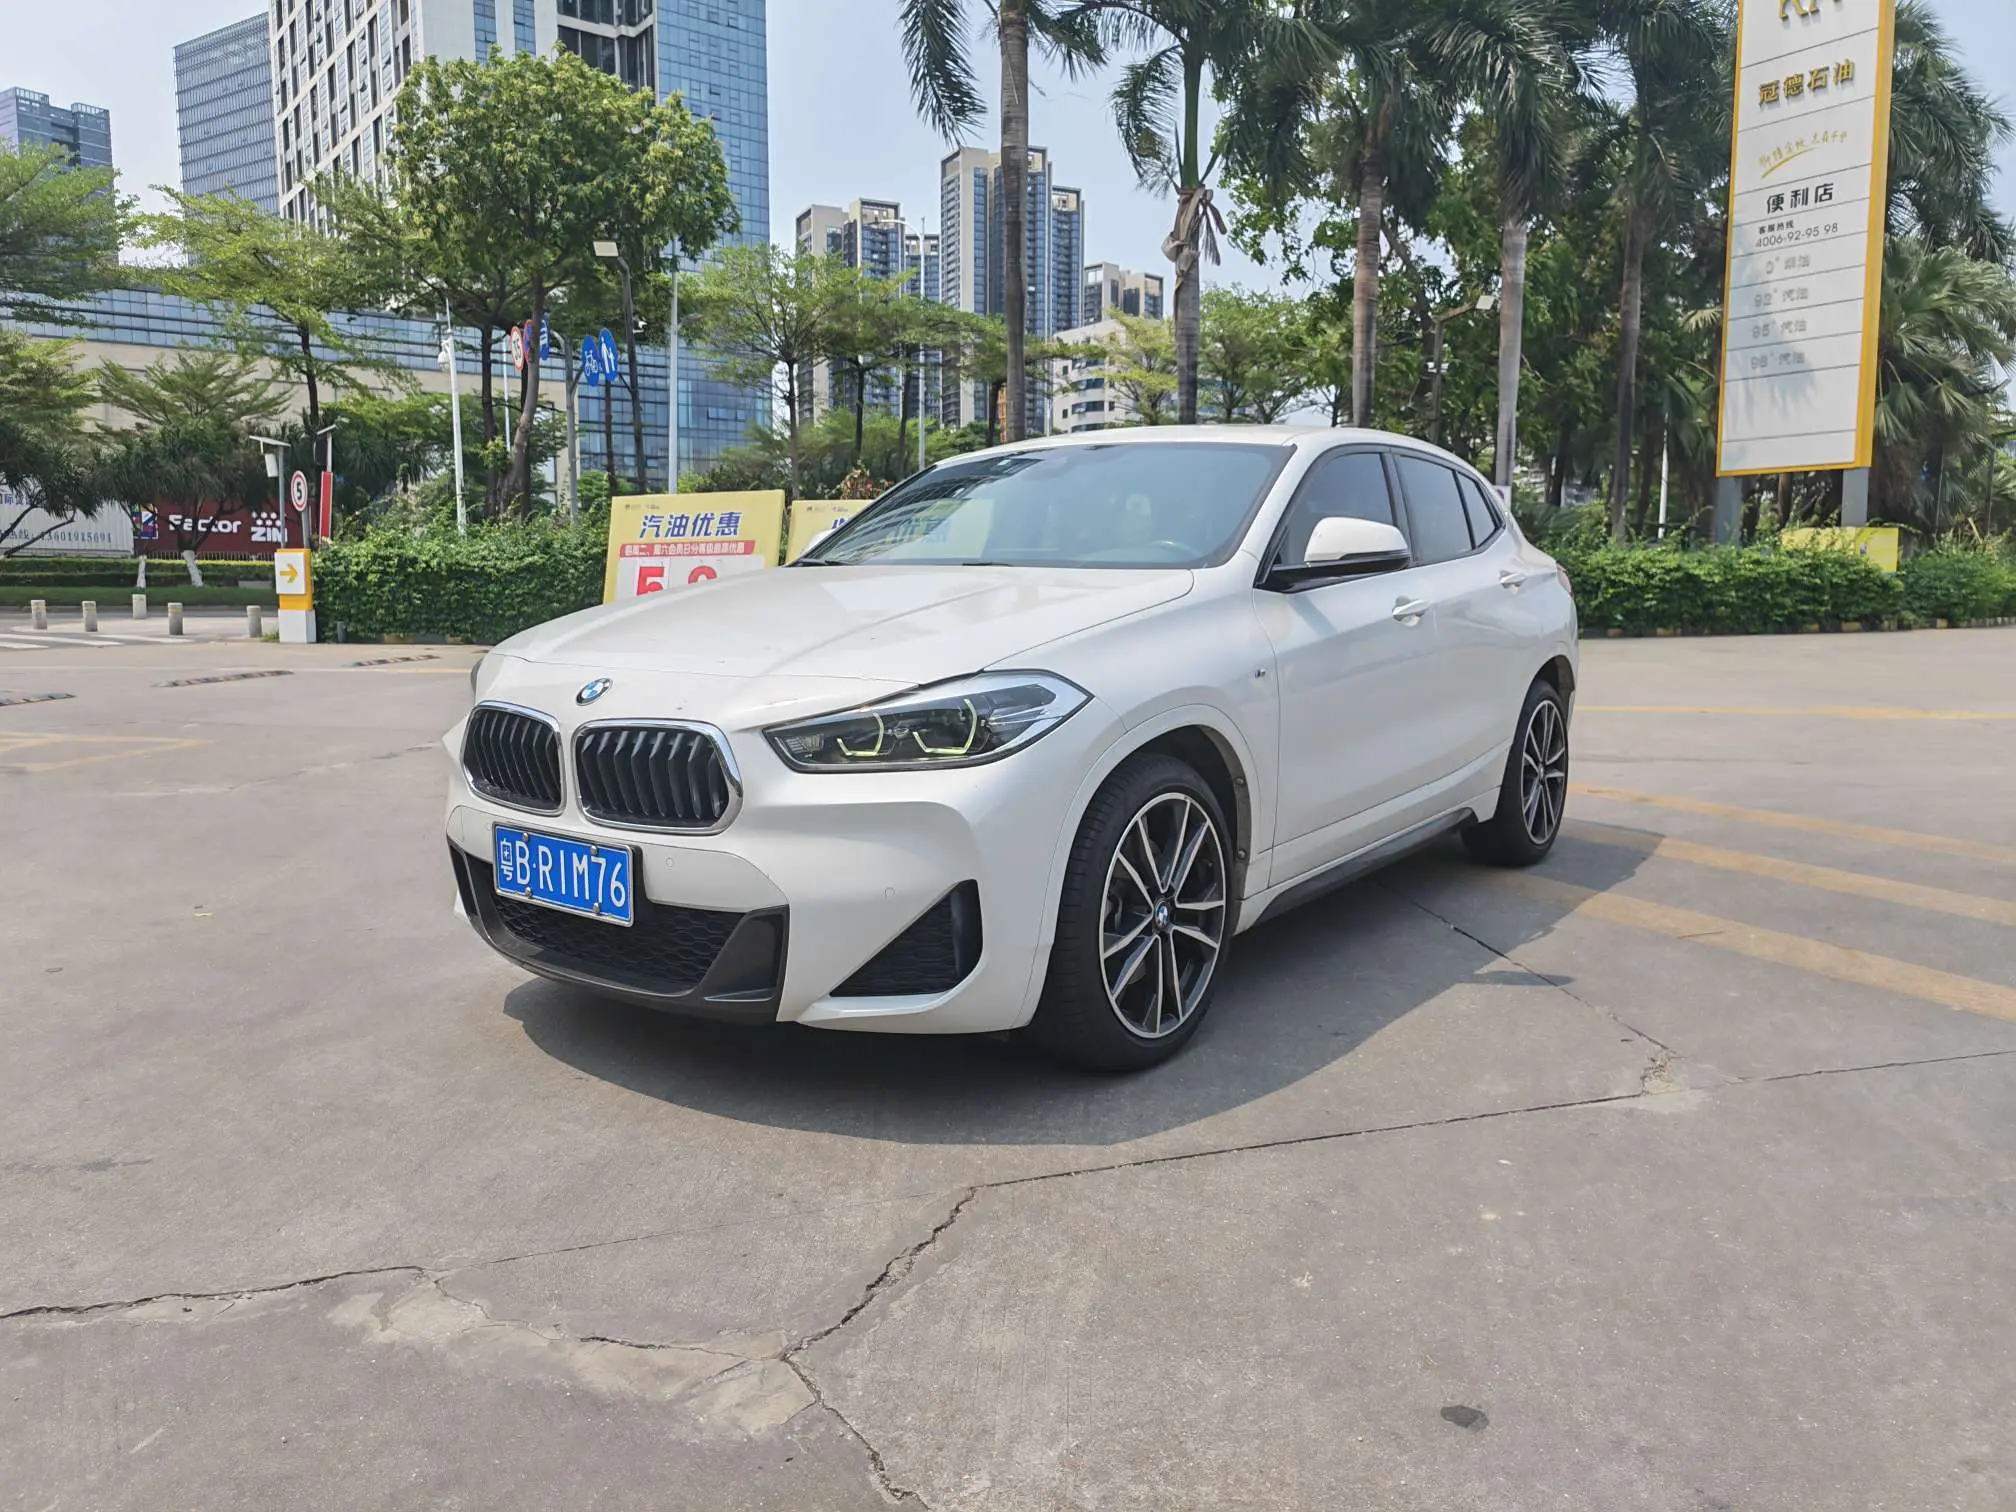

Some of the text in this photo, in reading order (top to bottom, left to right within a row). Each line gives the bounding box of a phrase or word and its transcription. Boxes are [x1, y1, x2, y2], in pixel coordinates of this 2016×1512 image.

[1759, 59, 1854, 105] 冠德石油
[1766, 182, 1834, 214] 便利店
[1758, 219, 1794, 235] 客服热线
[296, 480, 303, 500] 5
[640, 512, 742, 538] 汽油优惠
[500, 838, 626, 908] 粤B·R1M76
